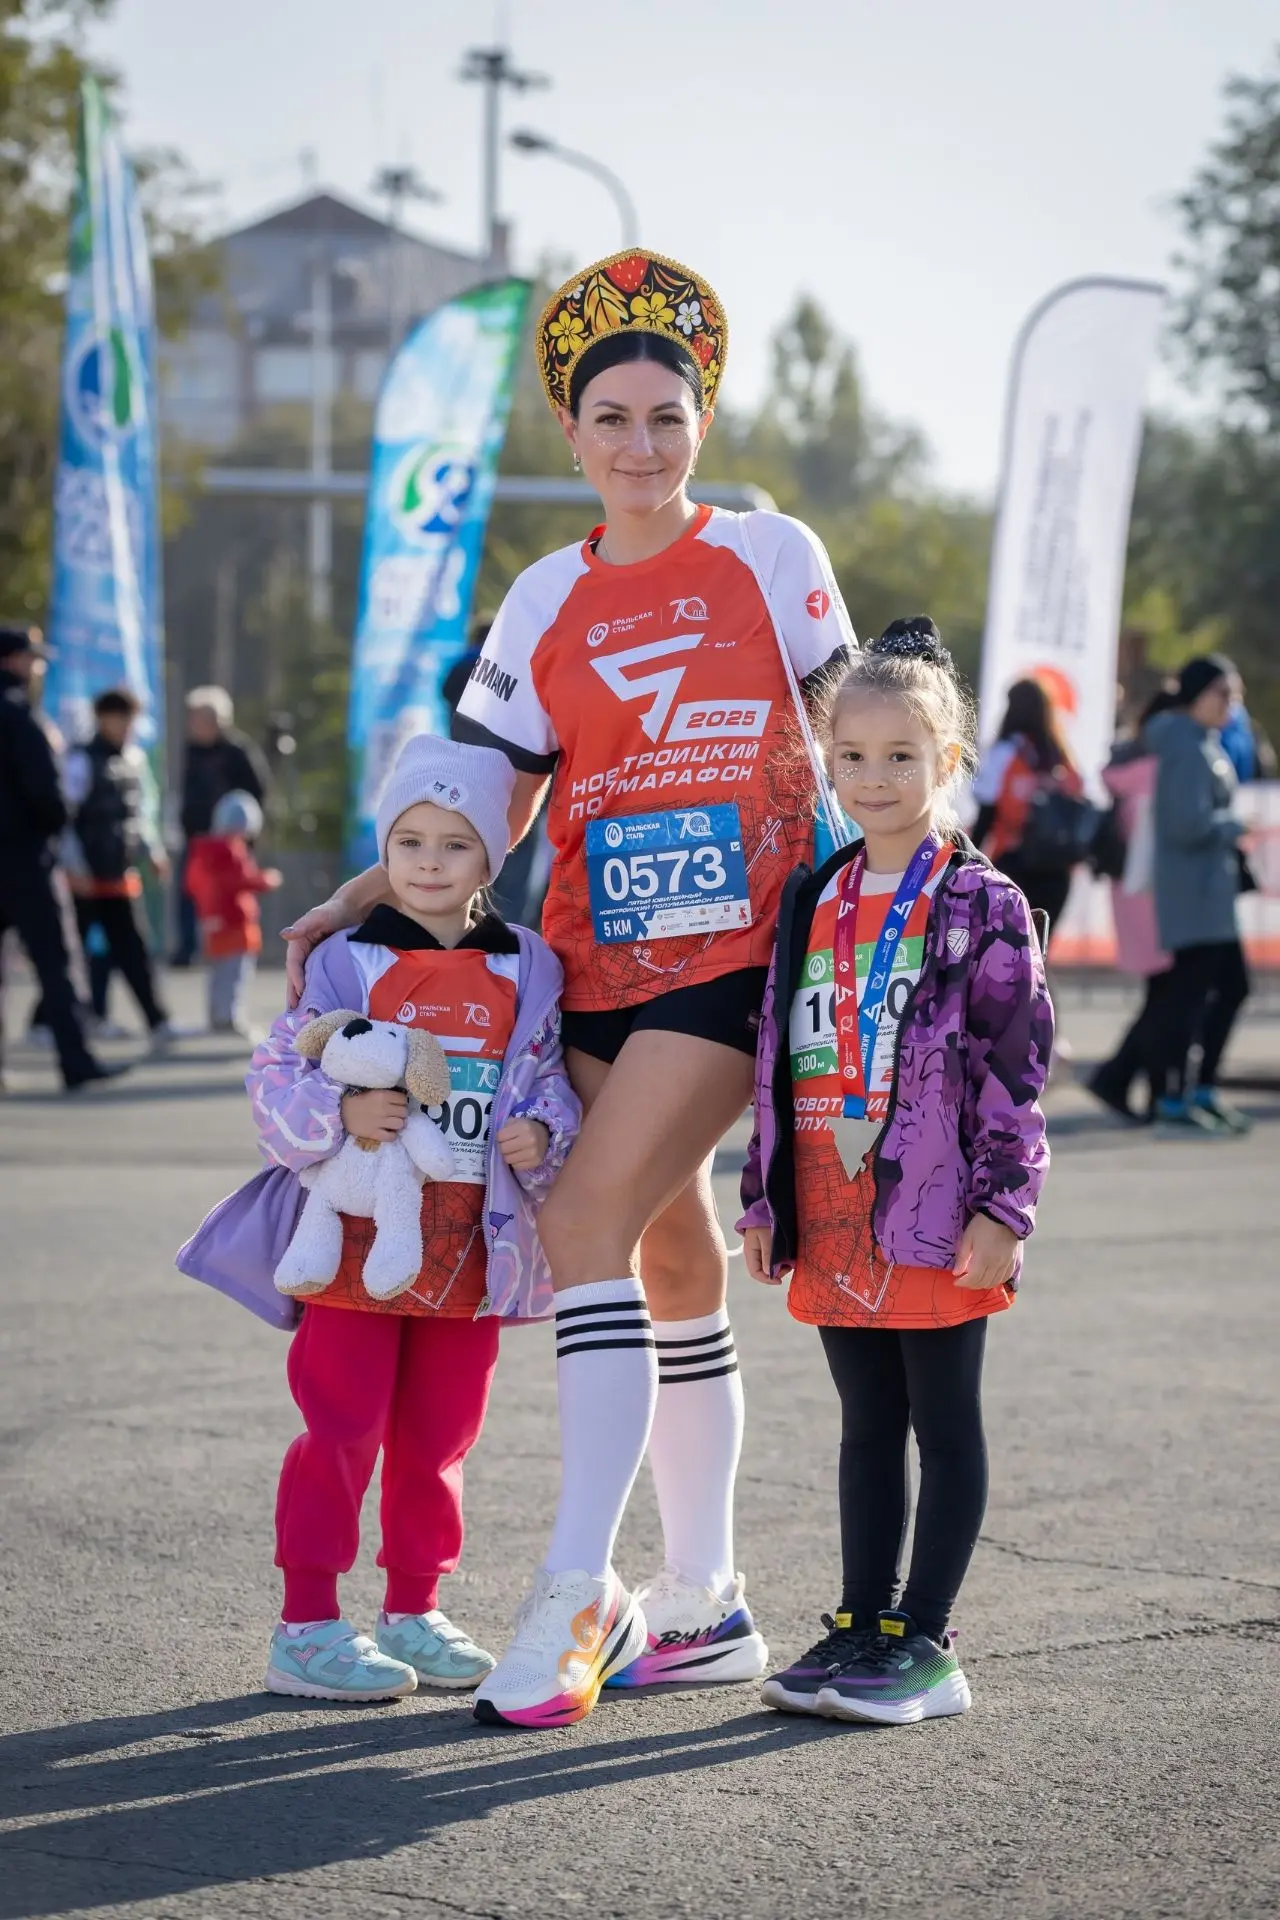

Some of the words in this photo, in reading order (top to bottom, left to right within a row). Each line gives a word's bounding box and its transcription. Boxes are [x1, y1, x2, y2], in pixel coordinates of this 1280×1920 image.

[669, 596, 710, 624] 70
[612, 611, 653, 627] УРАЛЬСКАЯ
[612, 624, 635, 634] СТАЛЬ
[685, 710, 757, 729] 2025
[571, 740, 760, 798] НОВТРОИЦКИЙ
[625, 822, 660, 833] УРАЛЬСКАЯ
[674, 811, 714, 839] 70
[626, 832, 644, 840] СТАЛЬ
[603, 846, 727, 901] 0573
[603, 921, 611, 937] 5
[419, 1005, 451, 1013] УРАЛЬСКАЯ
[797, 1054, 817, 1073] 300
